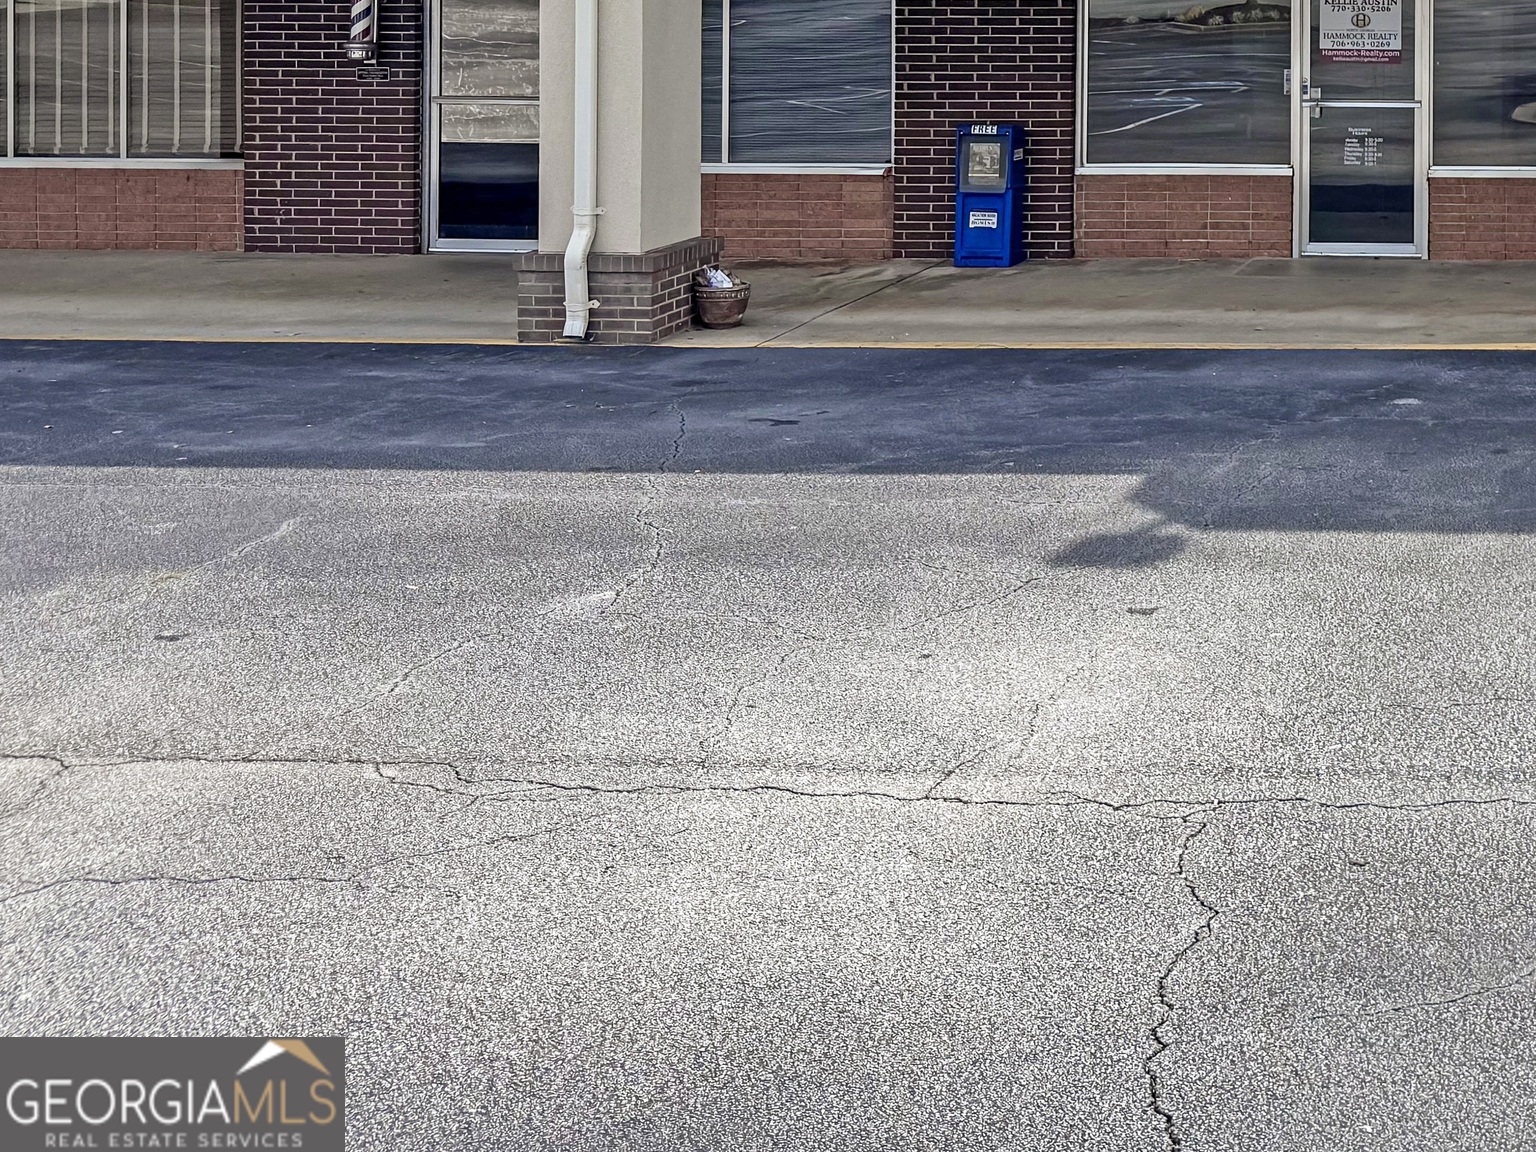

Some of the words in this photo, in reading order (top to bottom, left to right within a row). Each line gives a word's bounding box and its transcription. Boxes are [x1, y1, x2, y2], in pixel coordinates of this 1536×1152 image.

[1323, 32, 1366, 40] HAMMOCK
[1322, 49, 1400, 57] Hammock-Realty.com
[972, 125, 997, 135] FREE
